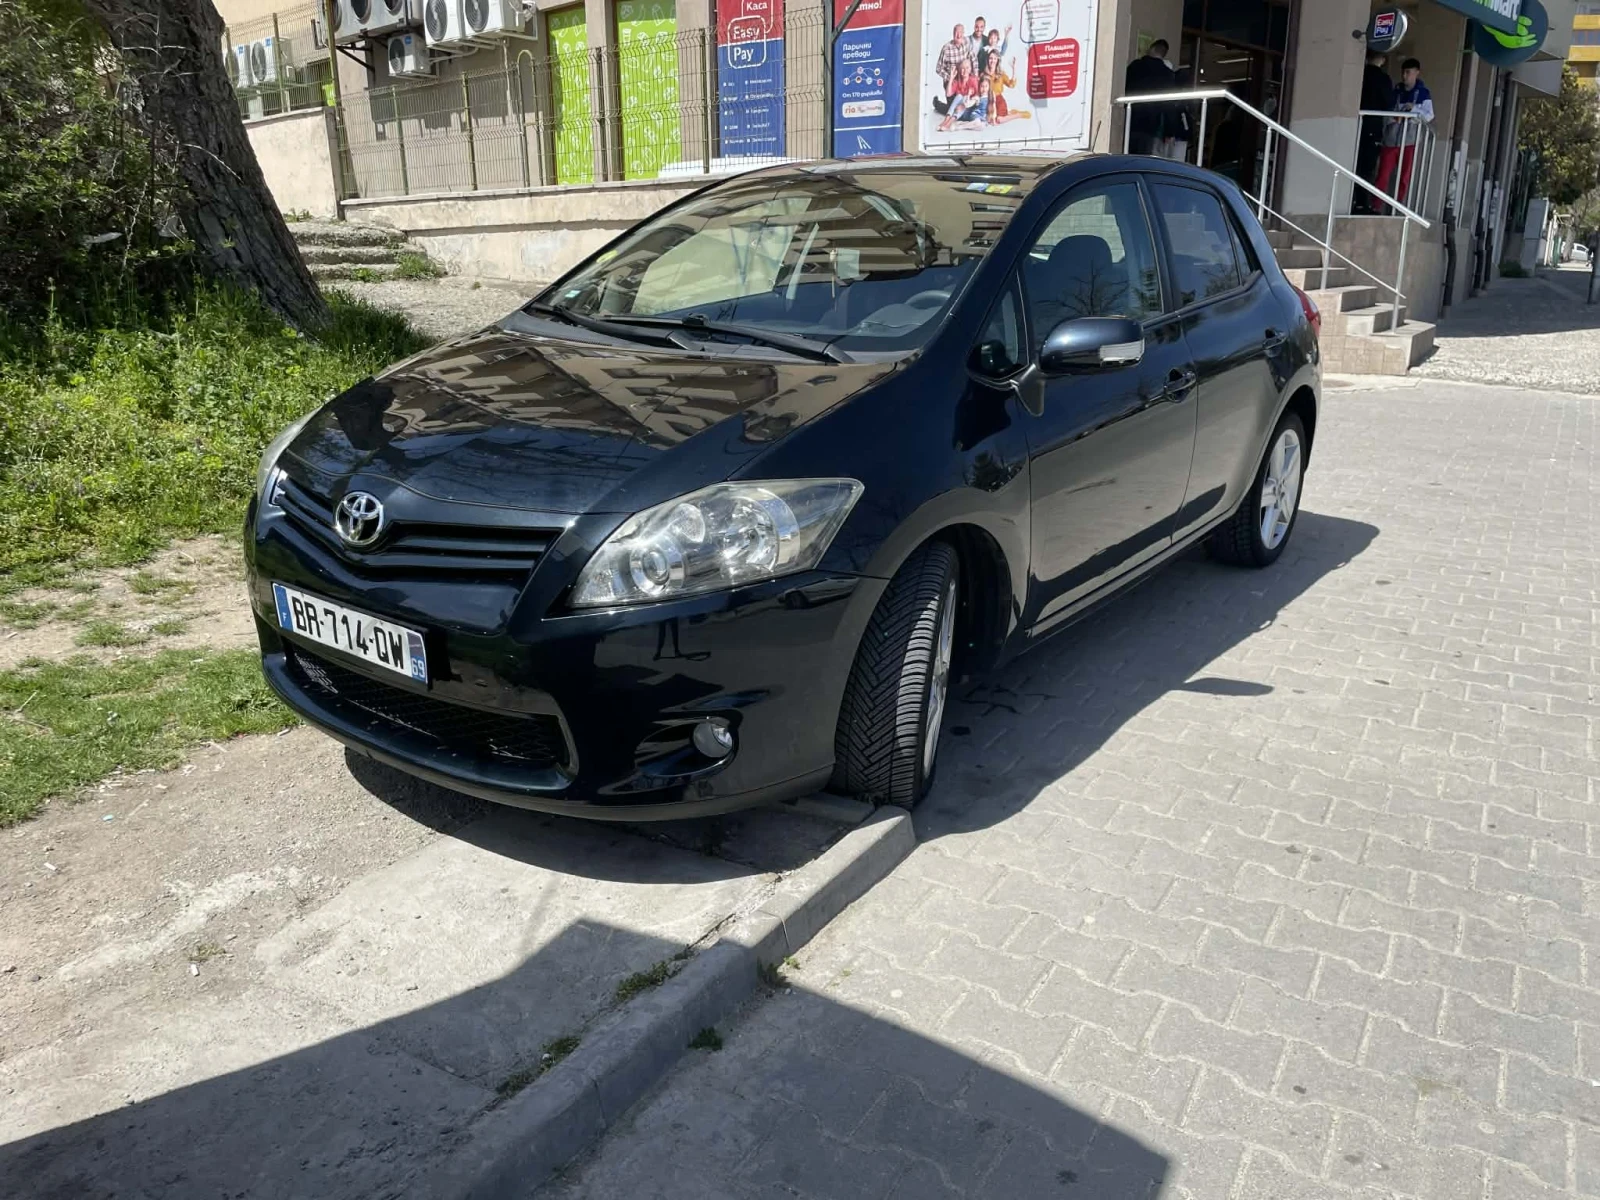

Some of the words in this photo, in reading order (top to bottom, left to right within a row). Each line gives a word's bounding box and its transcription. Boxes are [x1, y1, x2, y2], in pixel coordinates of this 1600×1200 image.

[746, 2, 768, 11] Каса
[1377, 18, 1393, 27] Easy
[733, 25, 760, 41] Easy
[1376, 26, 1389, 35] Pay
[843, 43, 872, 52] Парични
[733, 47, 754, 62] Pay
[842, 51, 871, 60] преводи
[282, 612, 288, 623] F
[291, 596, 405, 670] BR-714-QW
[411, 657, 426, 678] 69
